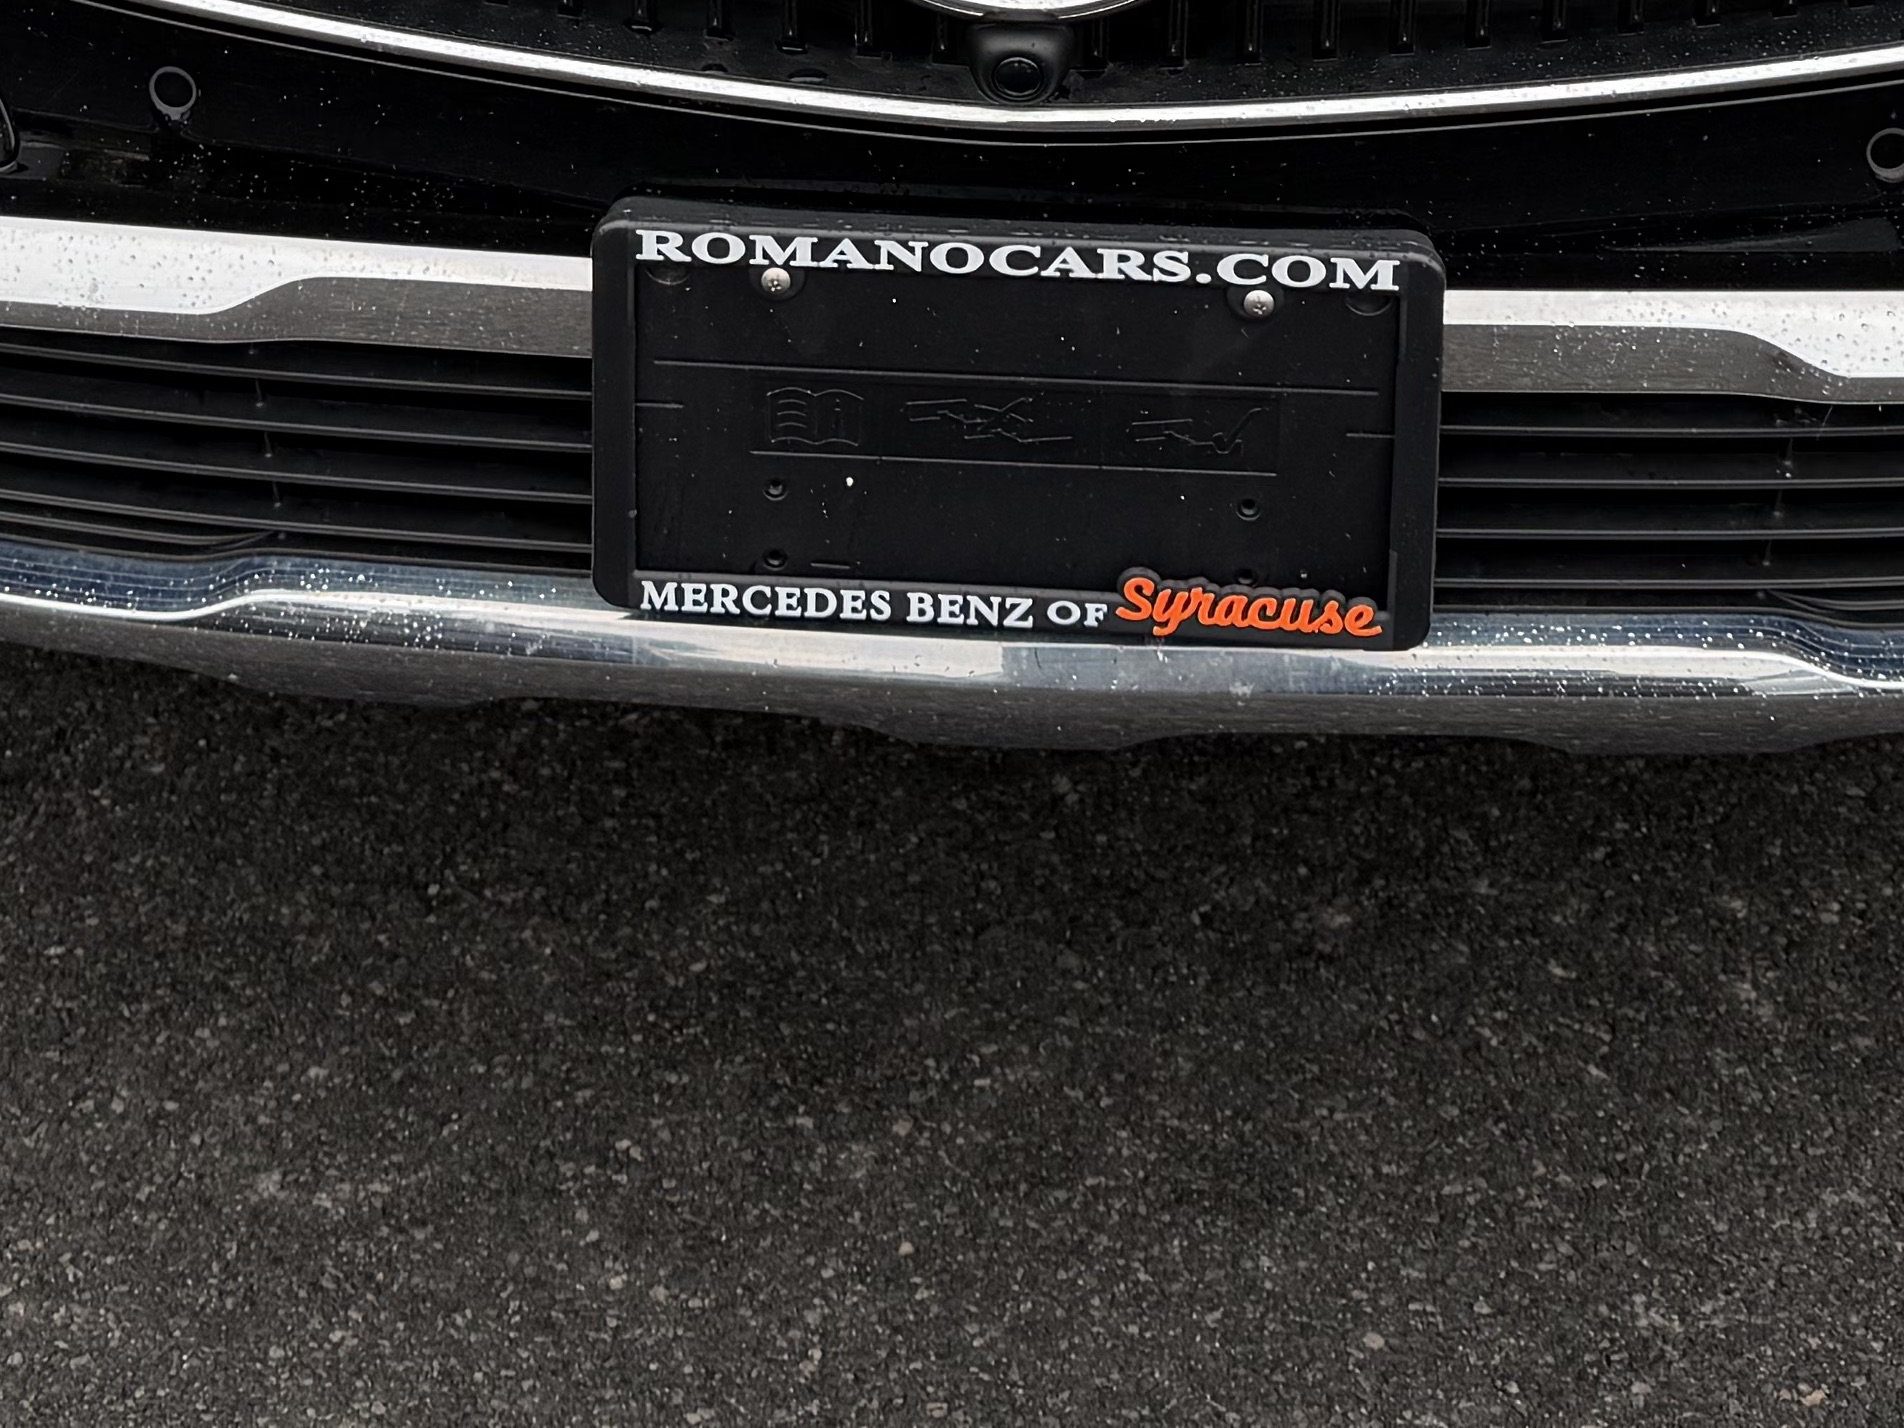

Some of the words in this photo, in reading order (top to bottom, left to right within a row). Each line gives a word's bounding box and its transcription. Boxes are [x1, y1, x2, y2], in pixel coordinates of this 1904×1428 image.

[635, 229, 1400, 291] ROMANOCARS.COM
[640, 580, 891, 622] MERCEDES
[906, 593, 1035, 628] BENZ
[1047, 600, 1107, 628] OF
[1115, 576, 1382, 638] Syracuse
